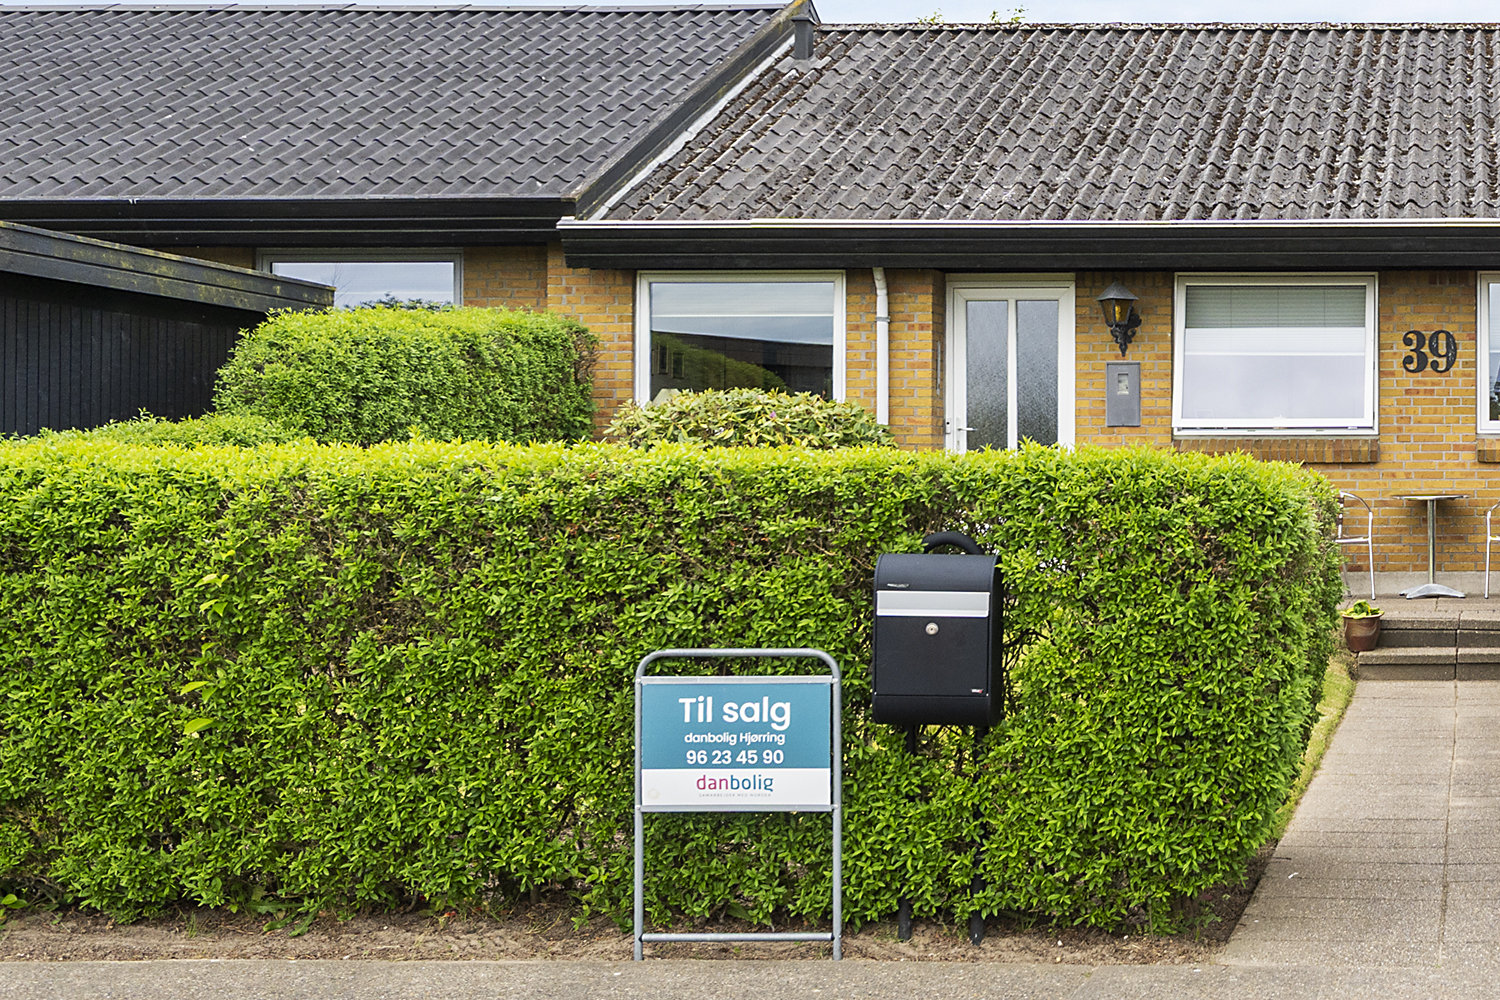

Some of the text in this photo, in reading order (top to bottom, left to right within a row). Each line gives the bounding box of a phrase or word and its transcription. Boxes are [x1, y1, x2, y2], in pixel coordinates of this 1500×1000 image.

[1402, 330, 1457, 373] 39
[678, 695, 791, 731] Til salg
[684, 732, 786, 746] danbolig Hjørring
[686, 749, 784, 764] 96 23 45 90
[696, 774, 774, 792] danbolig
